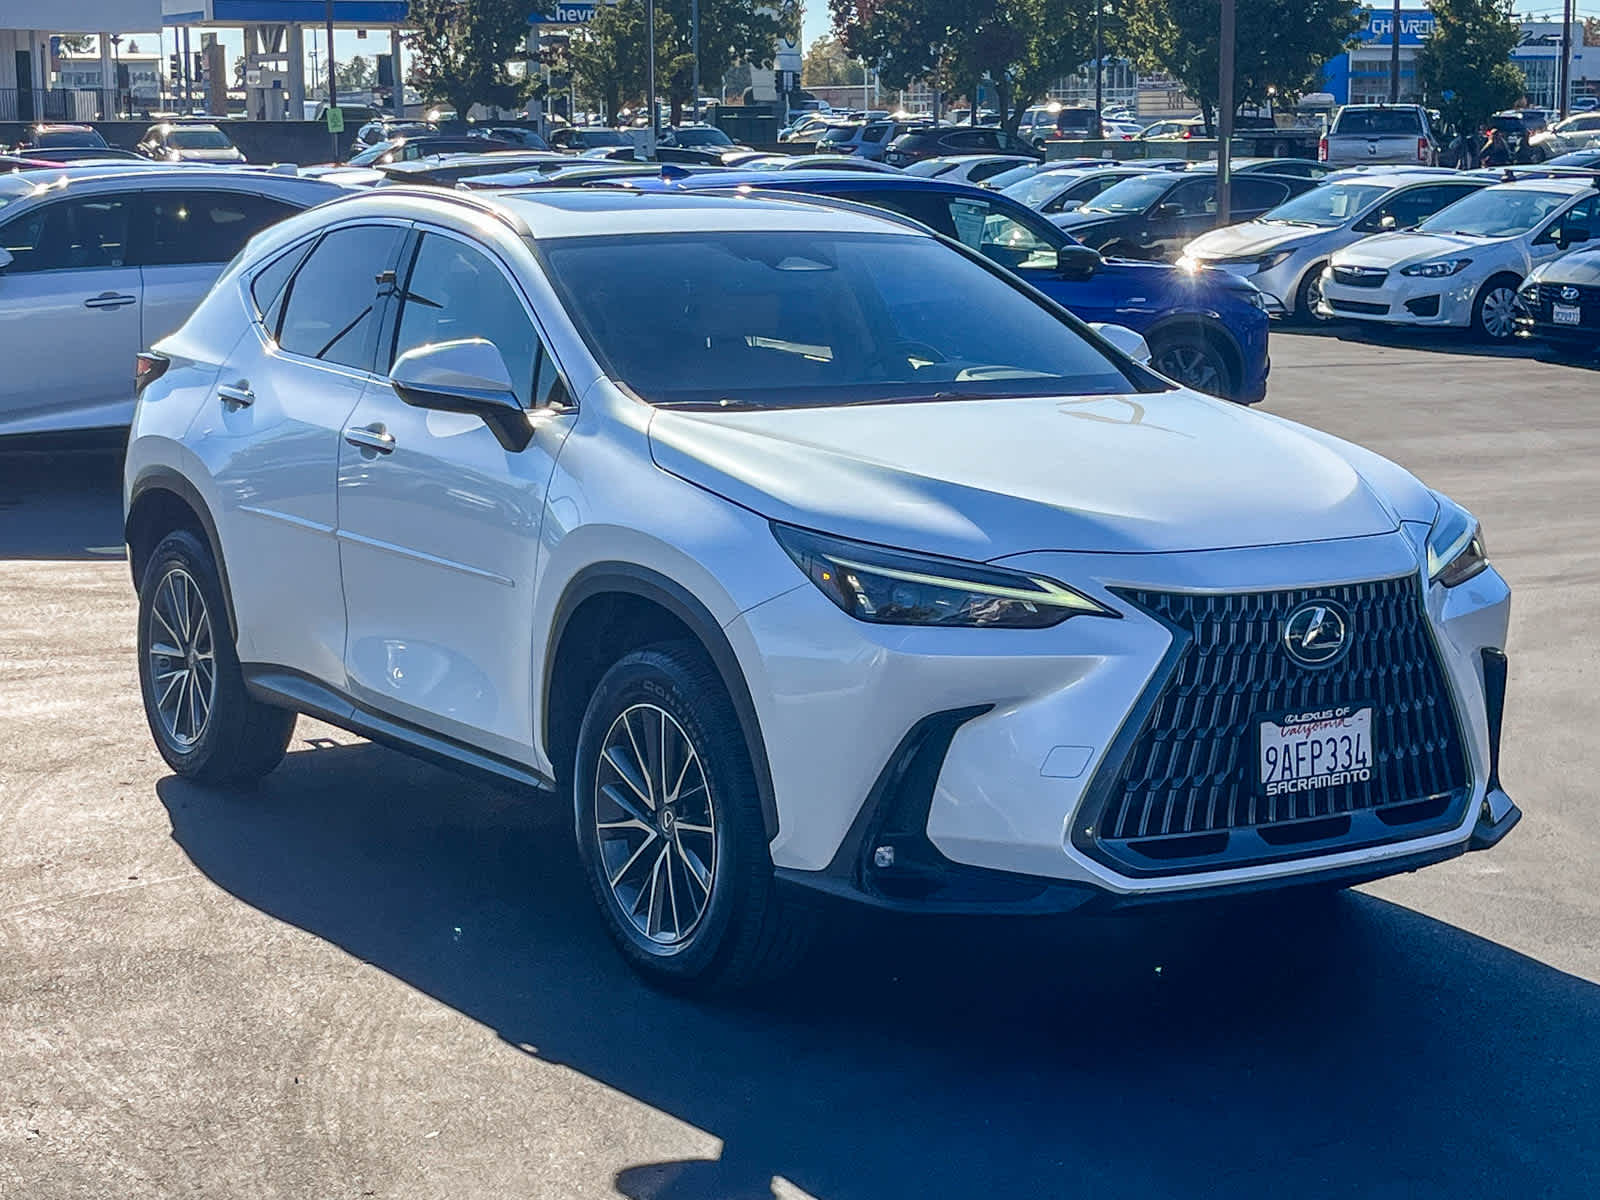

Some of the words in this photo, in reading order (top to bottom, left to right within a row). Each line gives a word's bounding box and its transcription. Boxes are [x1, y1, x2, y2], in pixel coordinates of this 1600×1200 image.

[1371, 19, 1436, 34] CHVROL
[1335, 706, 1350, 717] OF
[1265, 733, 1367, 783] 9AFP334
[1266, 768, 1370, 796] SACRAMENTO
